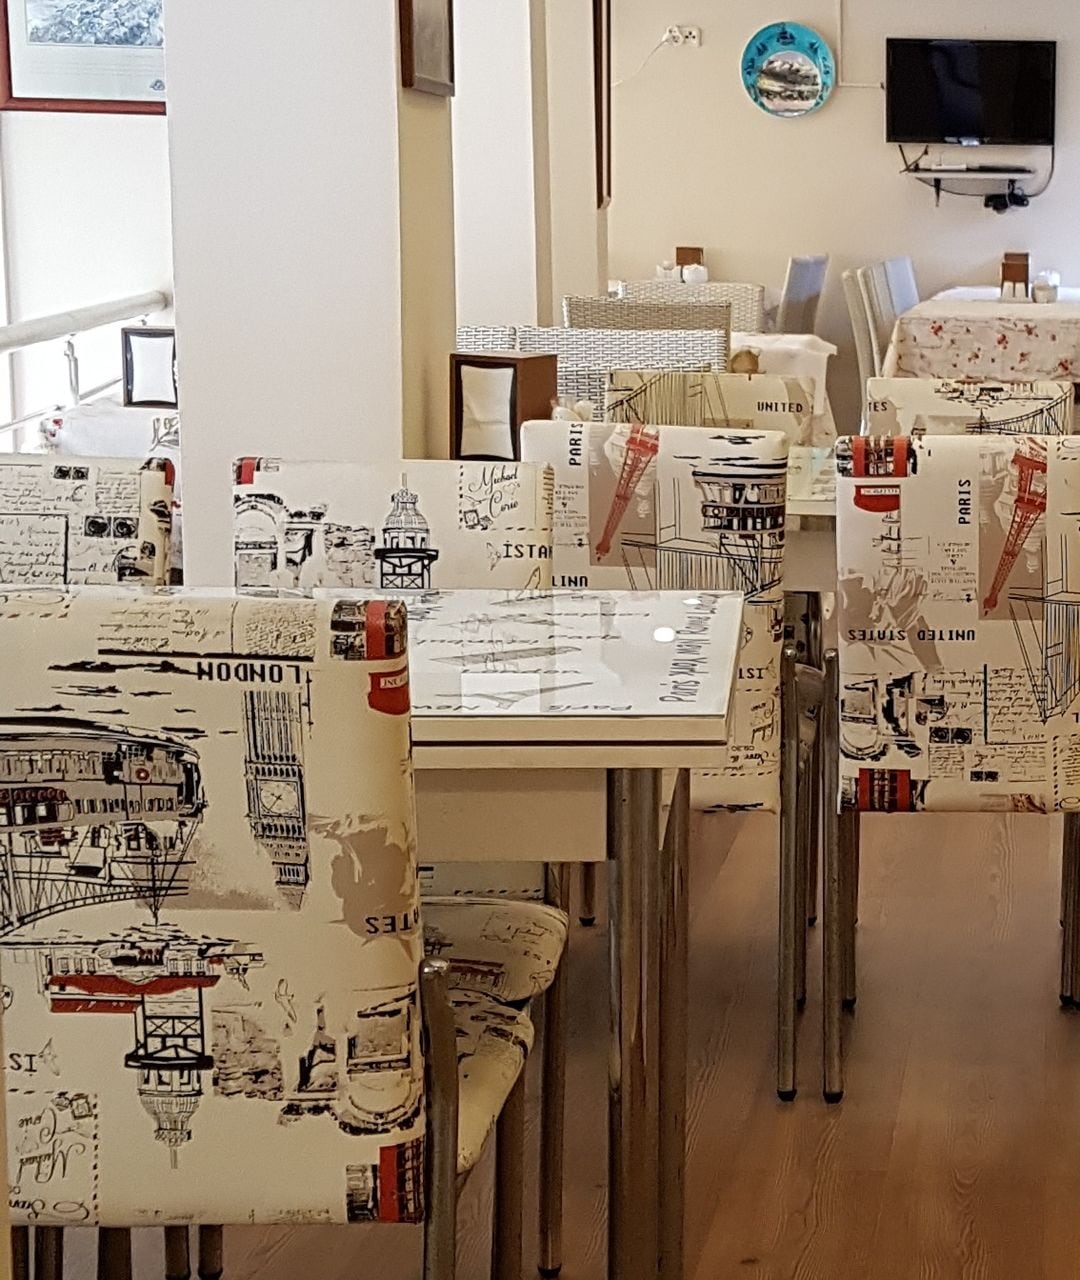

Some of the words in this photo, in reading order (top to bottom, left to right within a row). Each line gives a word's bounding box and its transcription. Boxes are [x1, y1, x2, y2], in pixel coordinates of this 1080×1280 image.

[757, 401, 803, 413] UNITED
[569, 423, 584, 466] PARIS
[958, 478, 971, 525] PARIS
[848, 628, 907, 641] STATES
[917, 629, 976, 642] UNITED
[197, 662, 304, 684] LONDON
[3, 1052, 37, 1077] İS
